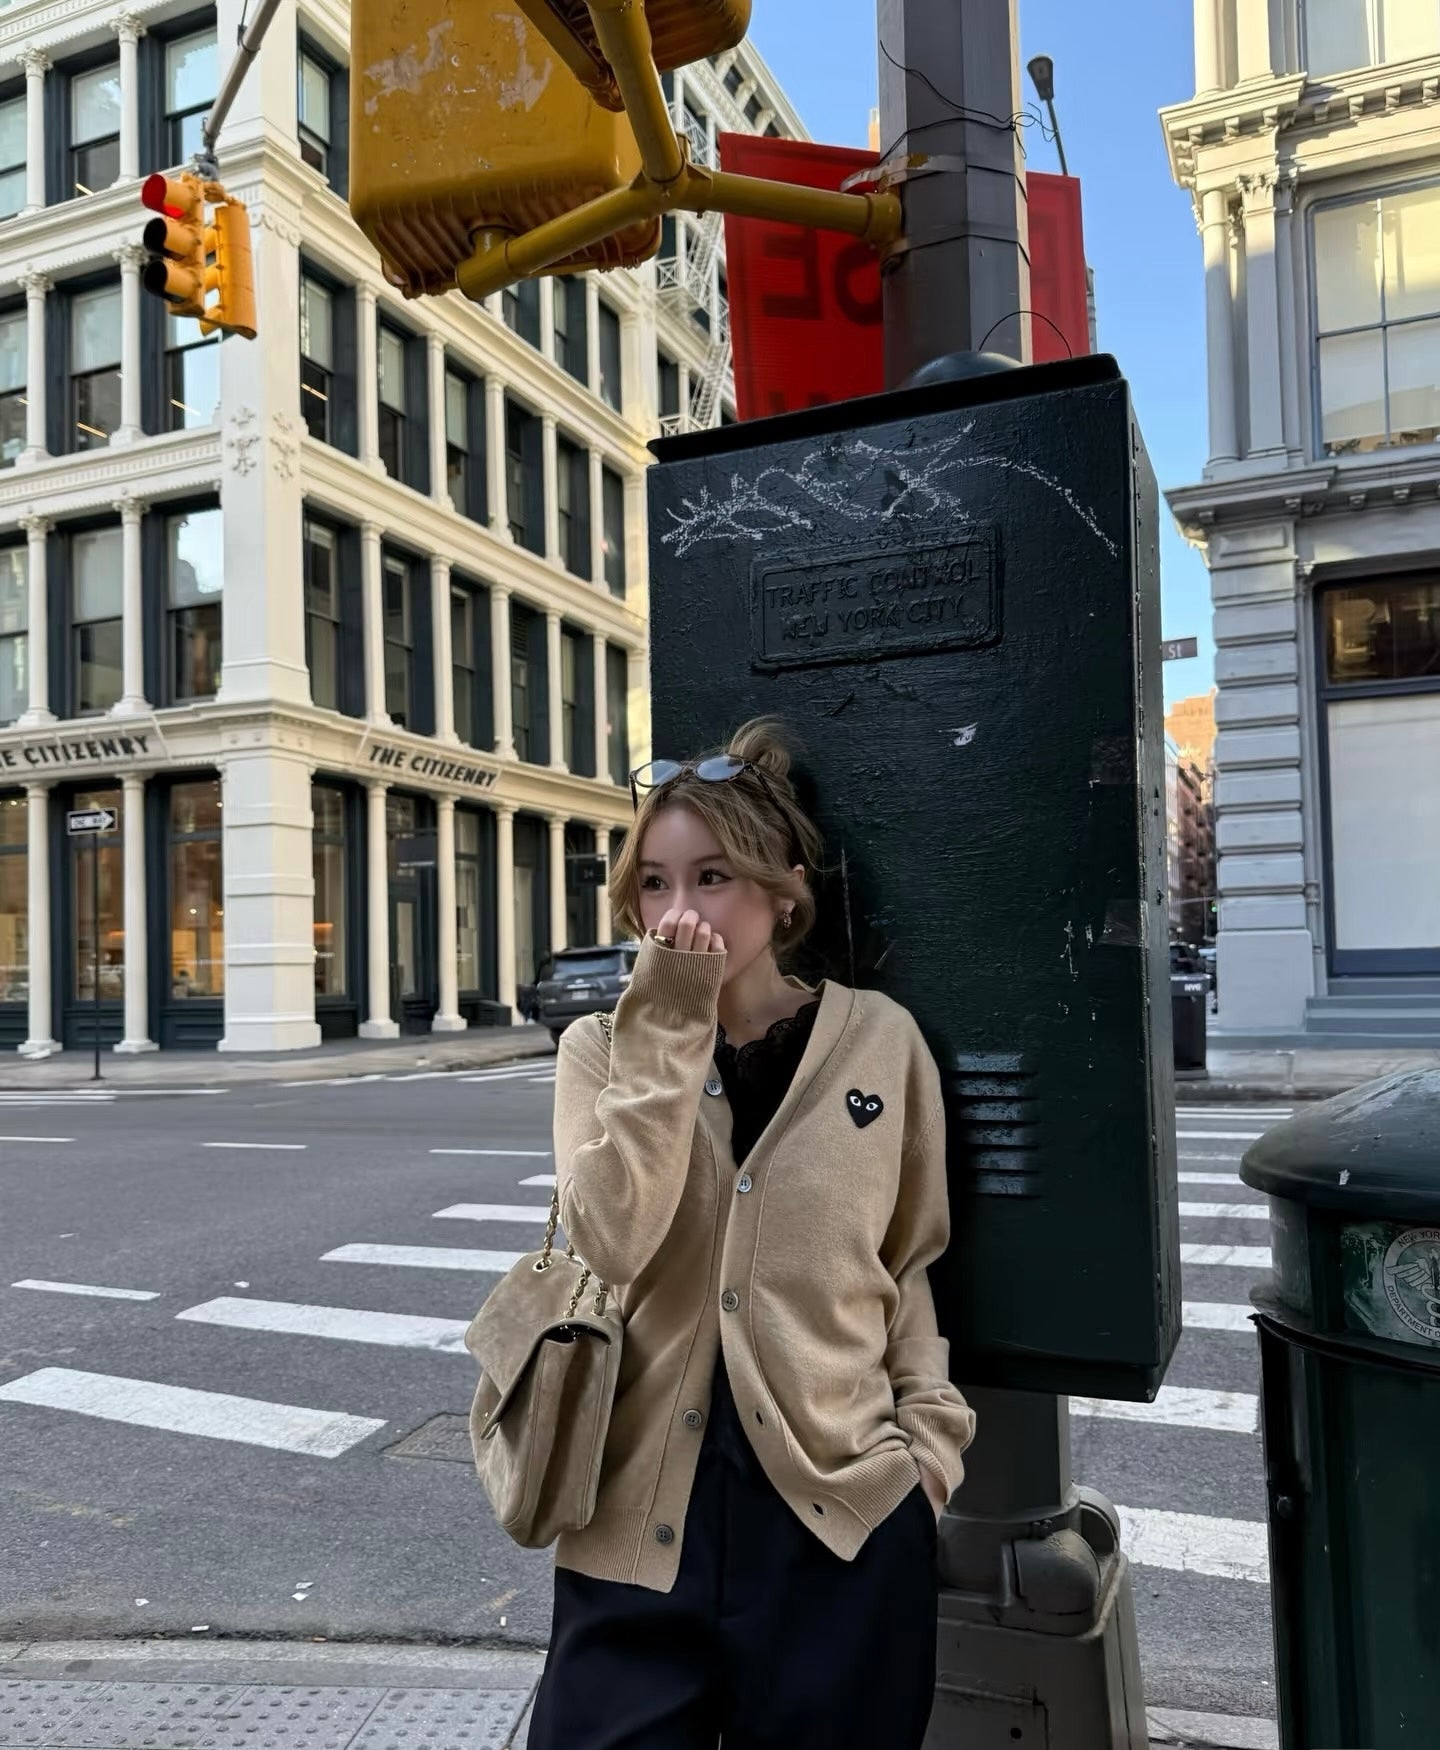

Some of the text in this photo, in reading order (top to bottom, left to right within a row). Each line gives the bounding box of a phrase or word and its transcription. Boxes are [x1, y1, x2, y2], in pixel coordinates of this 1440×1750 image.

[766, 576, 858, 608] TRAFFIC
[783, 595, 965, 640] NEW YORK CITY
[24, 735, 150, 764] CITIZENRY
[369, 745, 497, 787] THE CITIZENRY
[1398, 1231, 1418, 1247] NEW
[1387, 1285, 1433, 1336] DEPARTMENT
